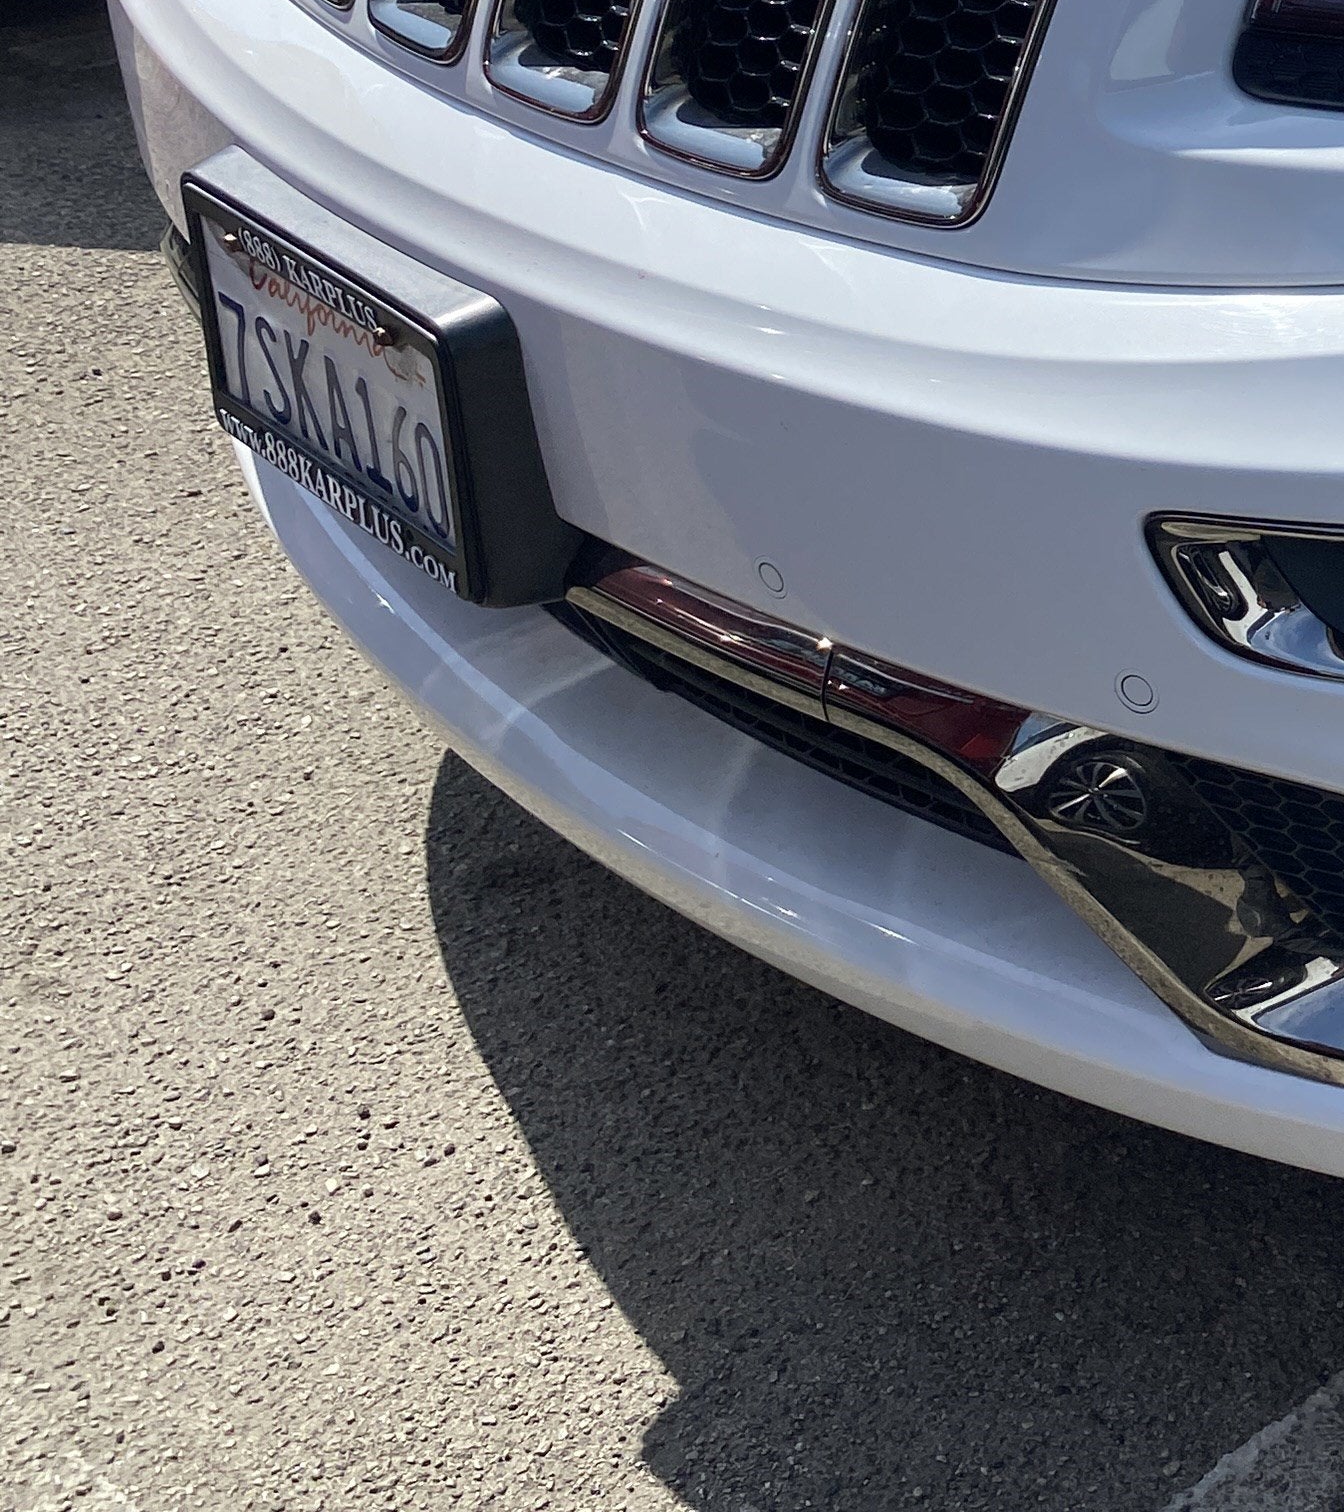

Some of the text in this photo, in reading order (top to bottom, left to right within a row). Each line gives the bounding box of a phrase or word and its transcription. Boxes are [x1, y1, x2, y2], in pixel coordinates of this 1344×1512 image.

[237, 227, 378, 332] (888) KARPLUS
[217, 291, 451, 539] 7SKA160
